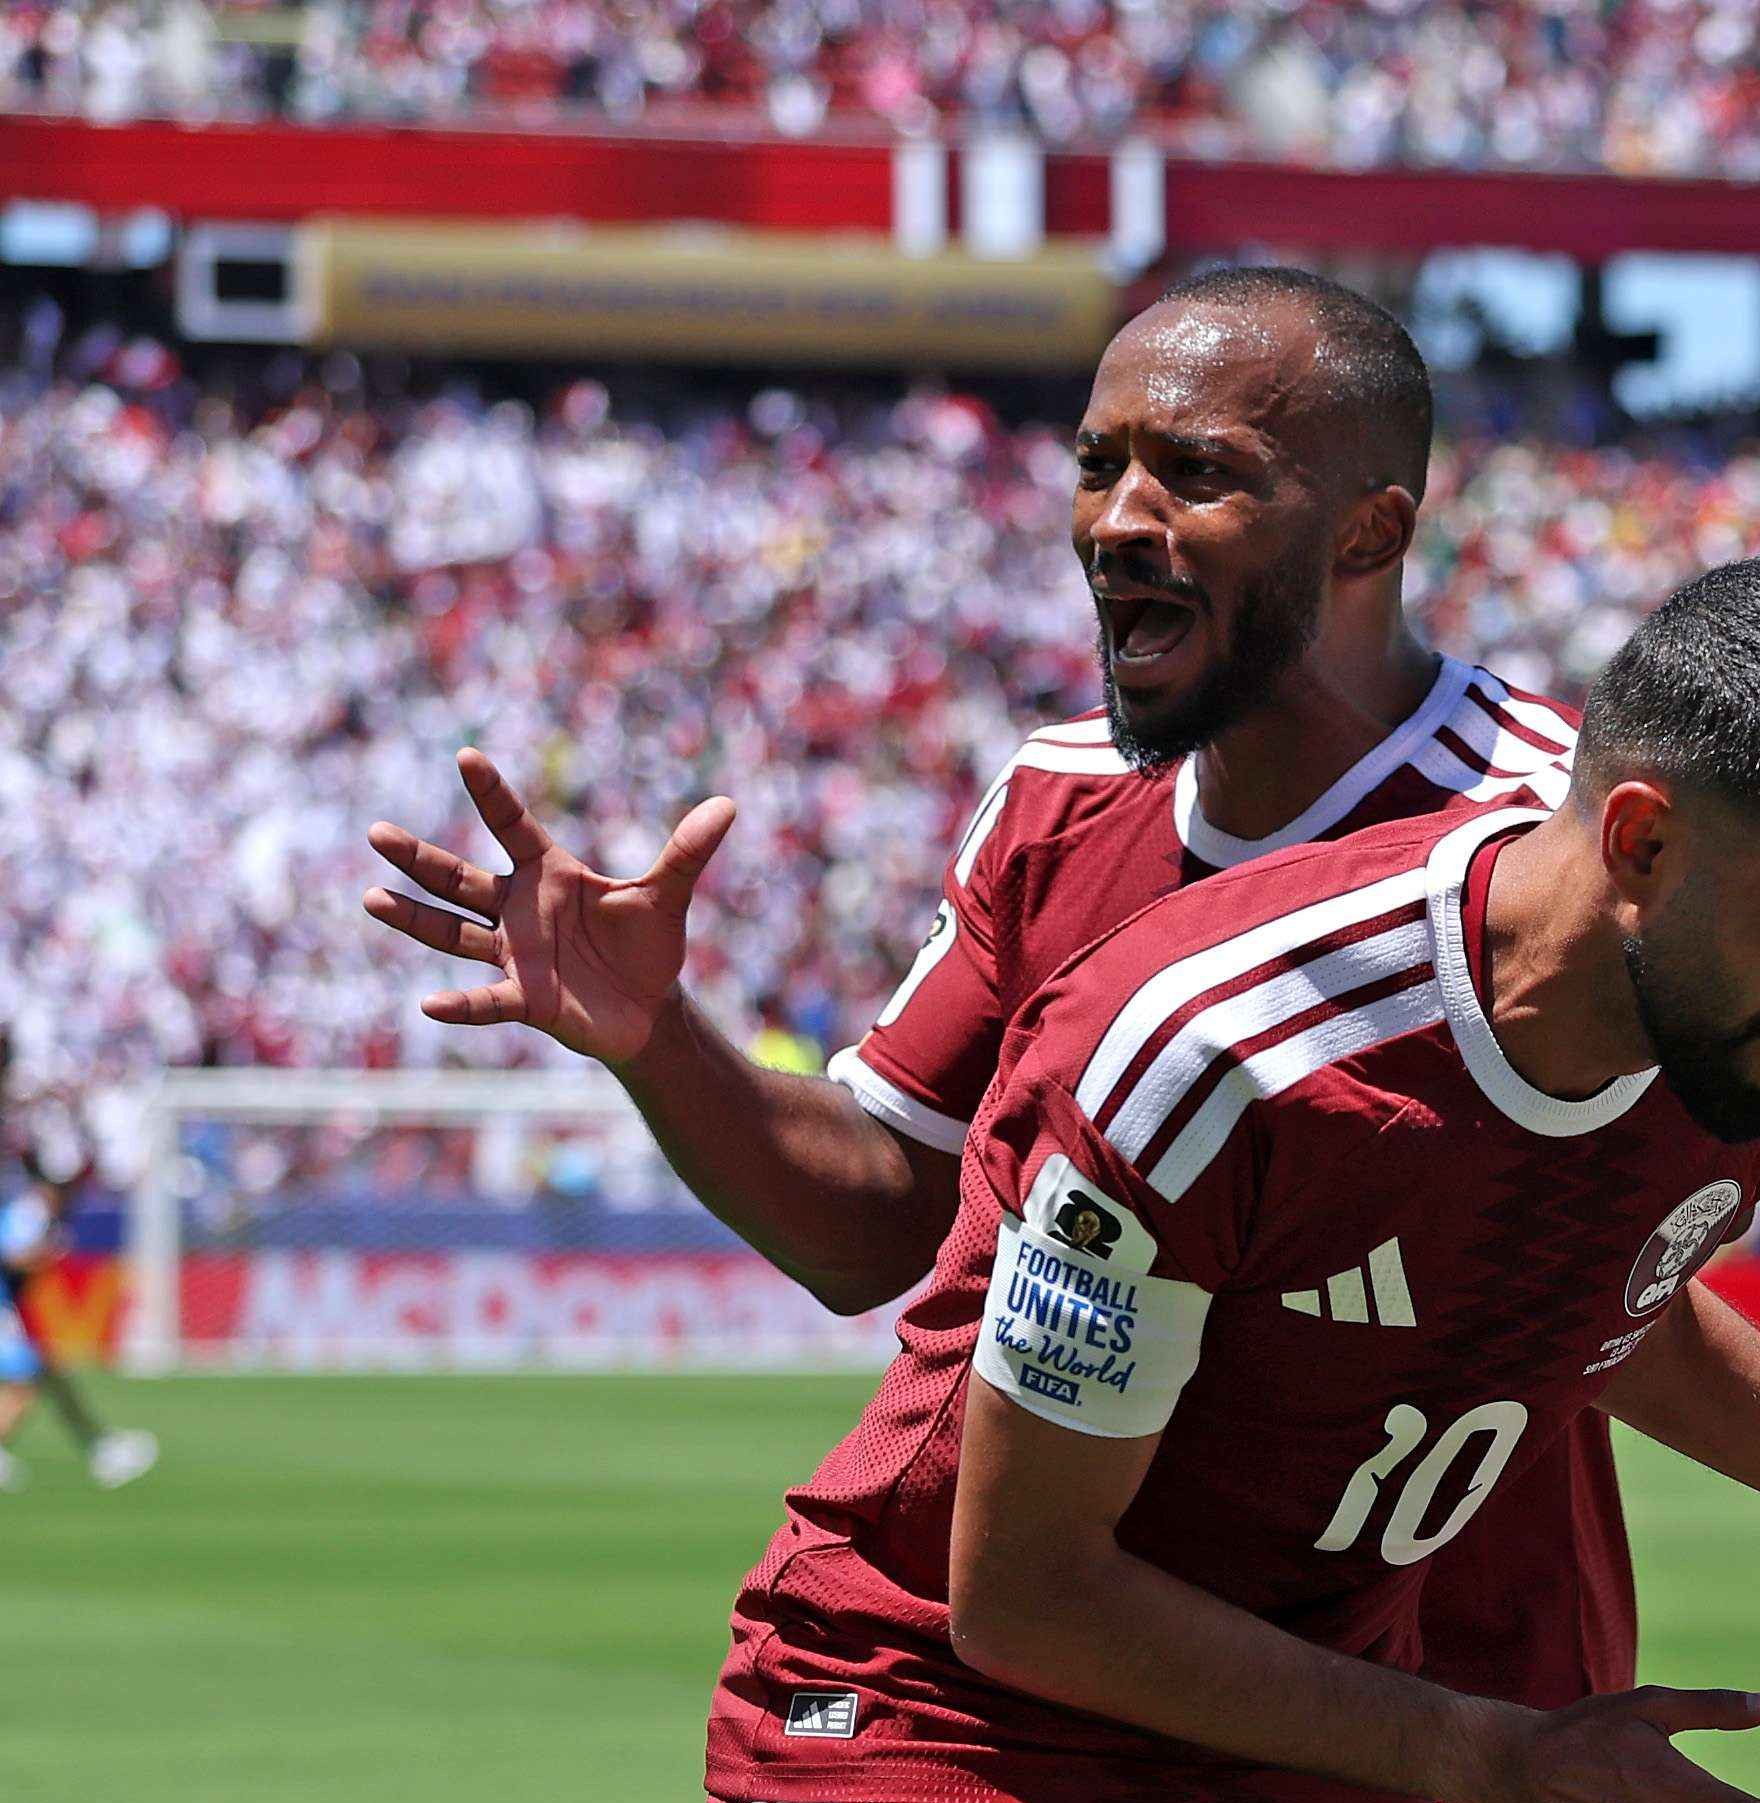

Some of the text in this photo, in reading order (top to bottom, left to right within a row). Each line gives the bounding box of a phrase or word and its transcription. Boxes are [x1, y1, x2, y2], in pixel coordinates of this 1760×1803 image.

[1006, 1272, 1135, 1354] UNITES
[1016, 1240, 1139, 1314] FOOTBALL
[994, 1315, 1137, 1394] the World
[1021, 1367, 1076, 1402] FIFA
[1313, 1400, 1528, 1567] 10
